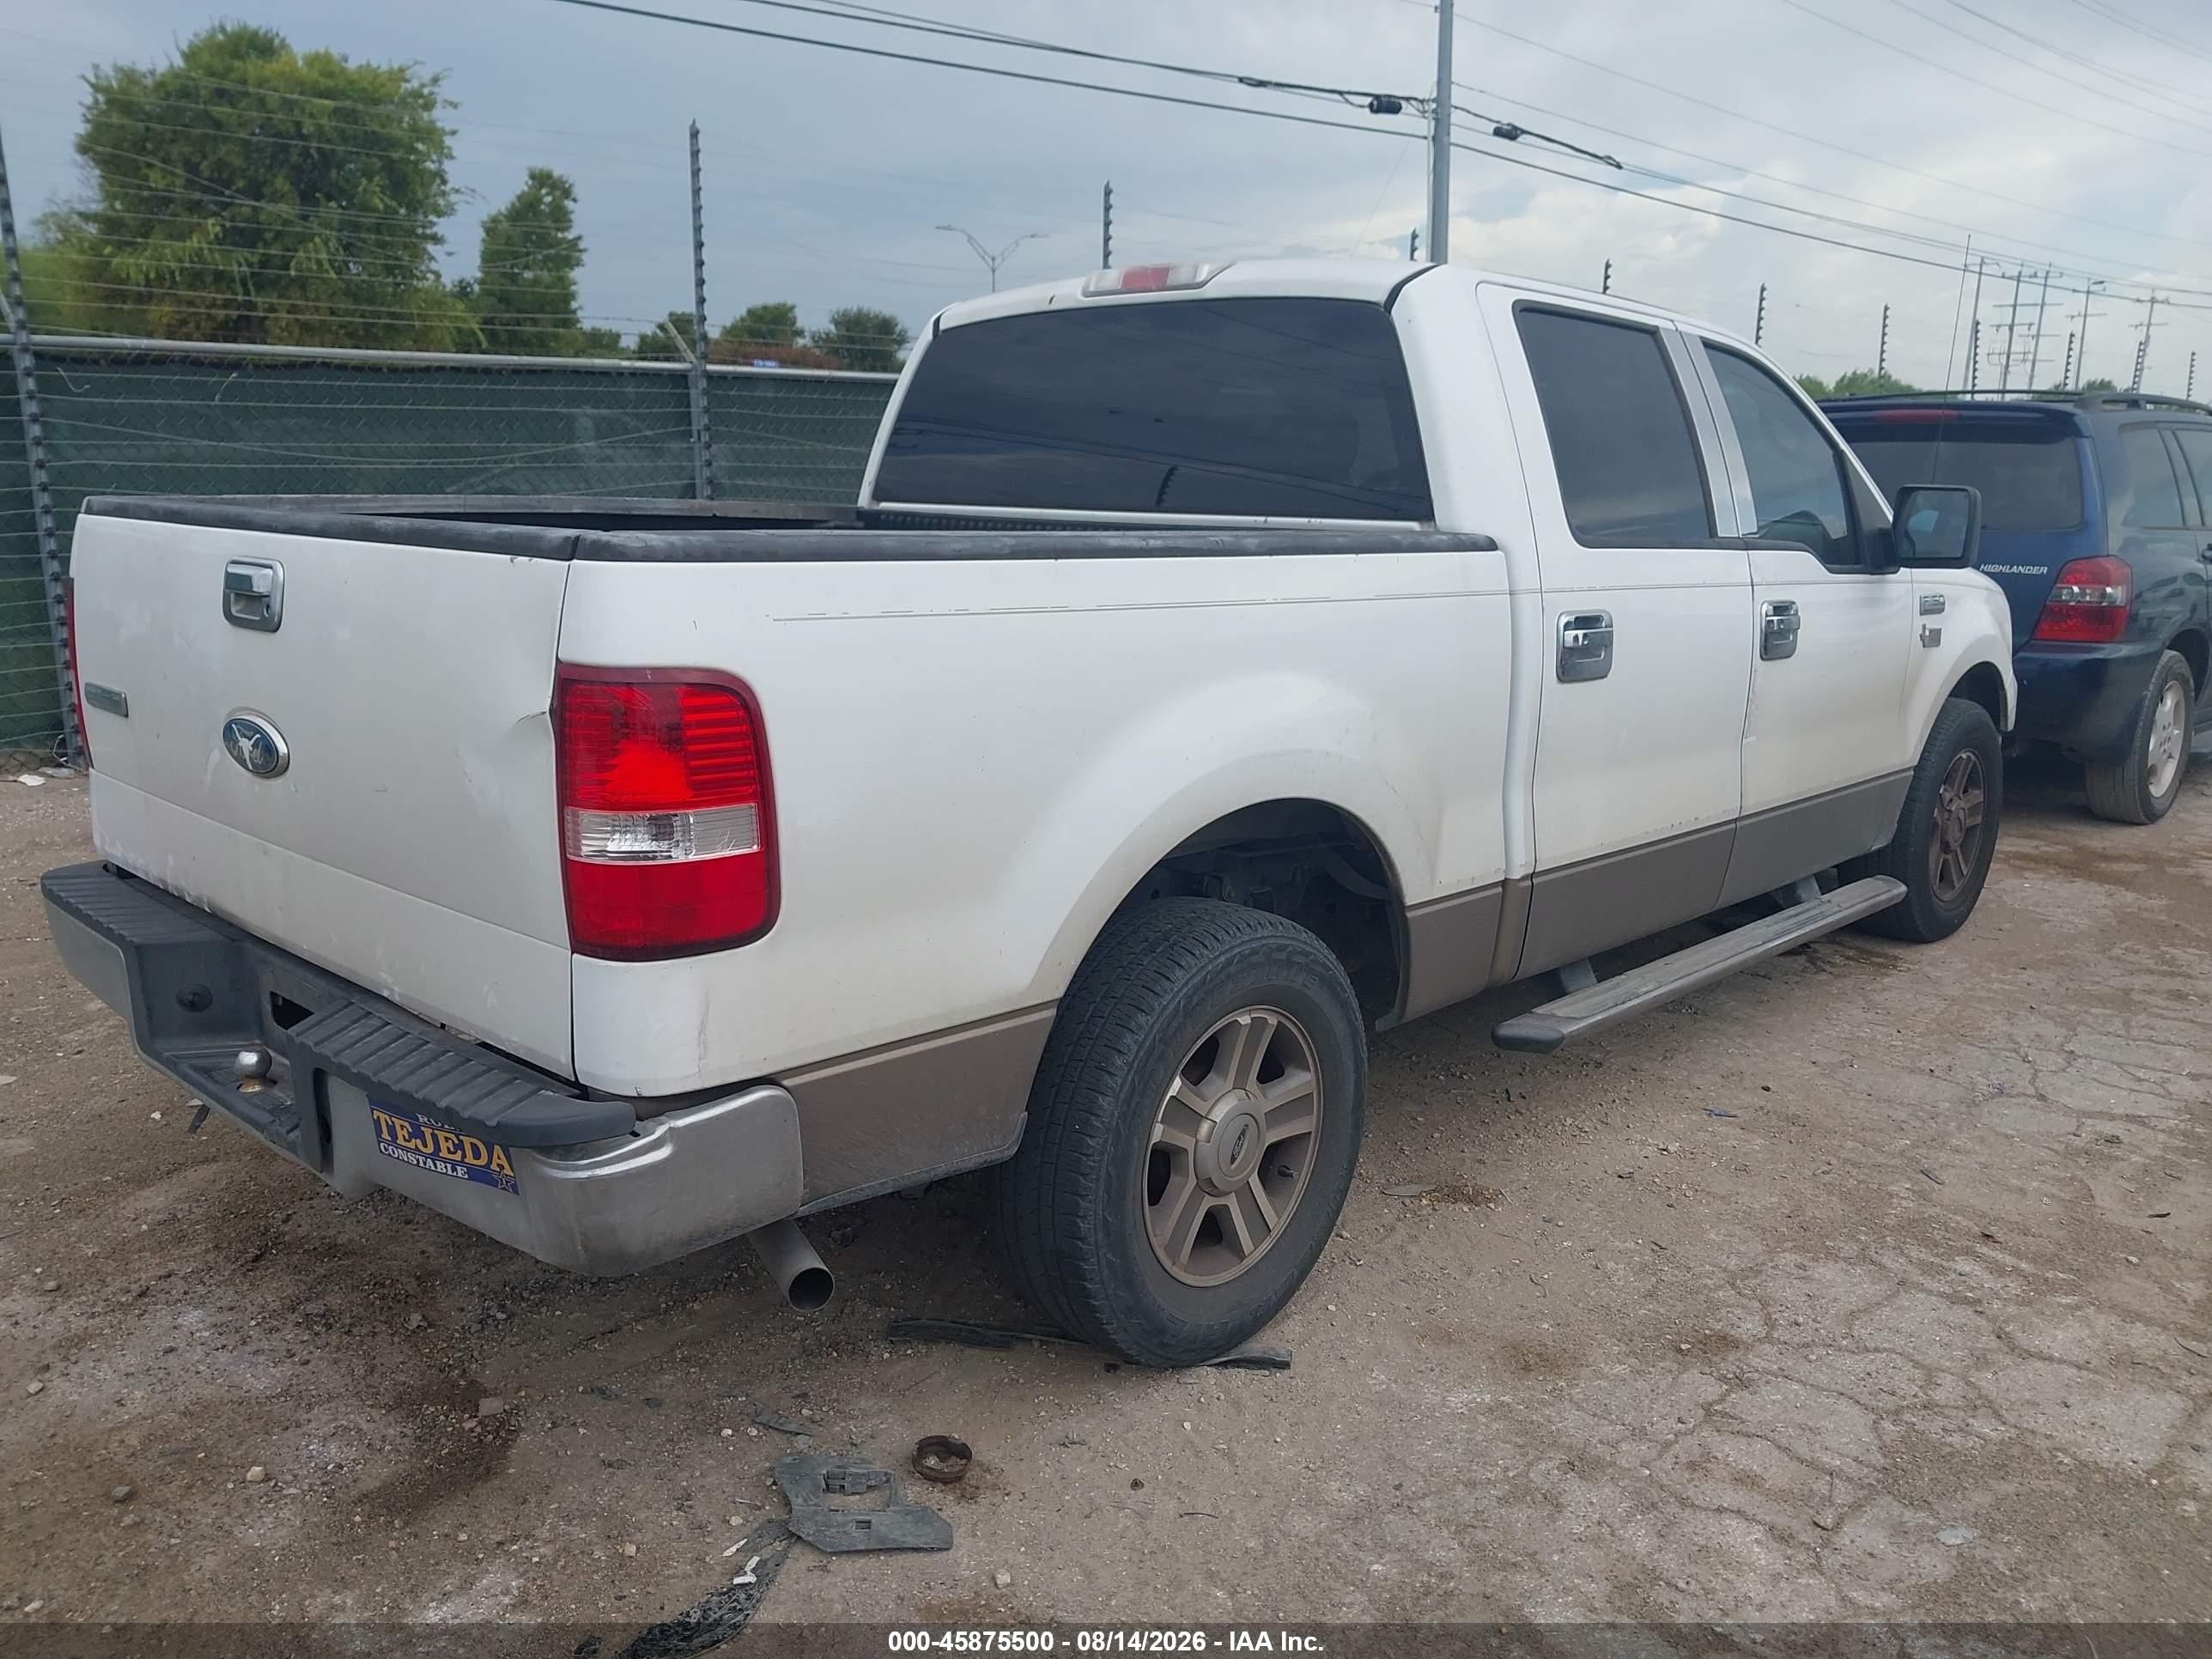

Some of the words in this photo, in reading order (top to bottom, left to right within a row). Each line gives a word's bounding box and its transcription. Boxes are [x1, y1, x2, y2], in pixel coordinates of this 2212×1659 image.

[1978, 562, 2049, 575] HIGHLANDER
[373, 1109, 515, 1177] TEJEDA
[380, 1142, 469, 1179] CONSTABLE
